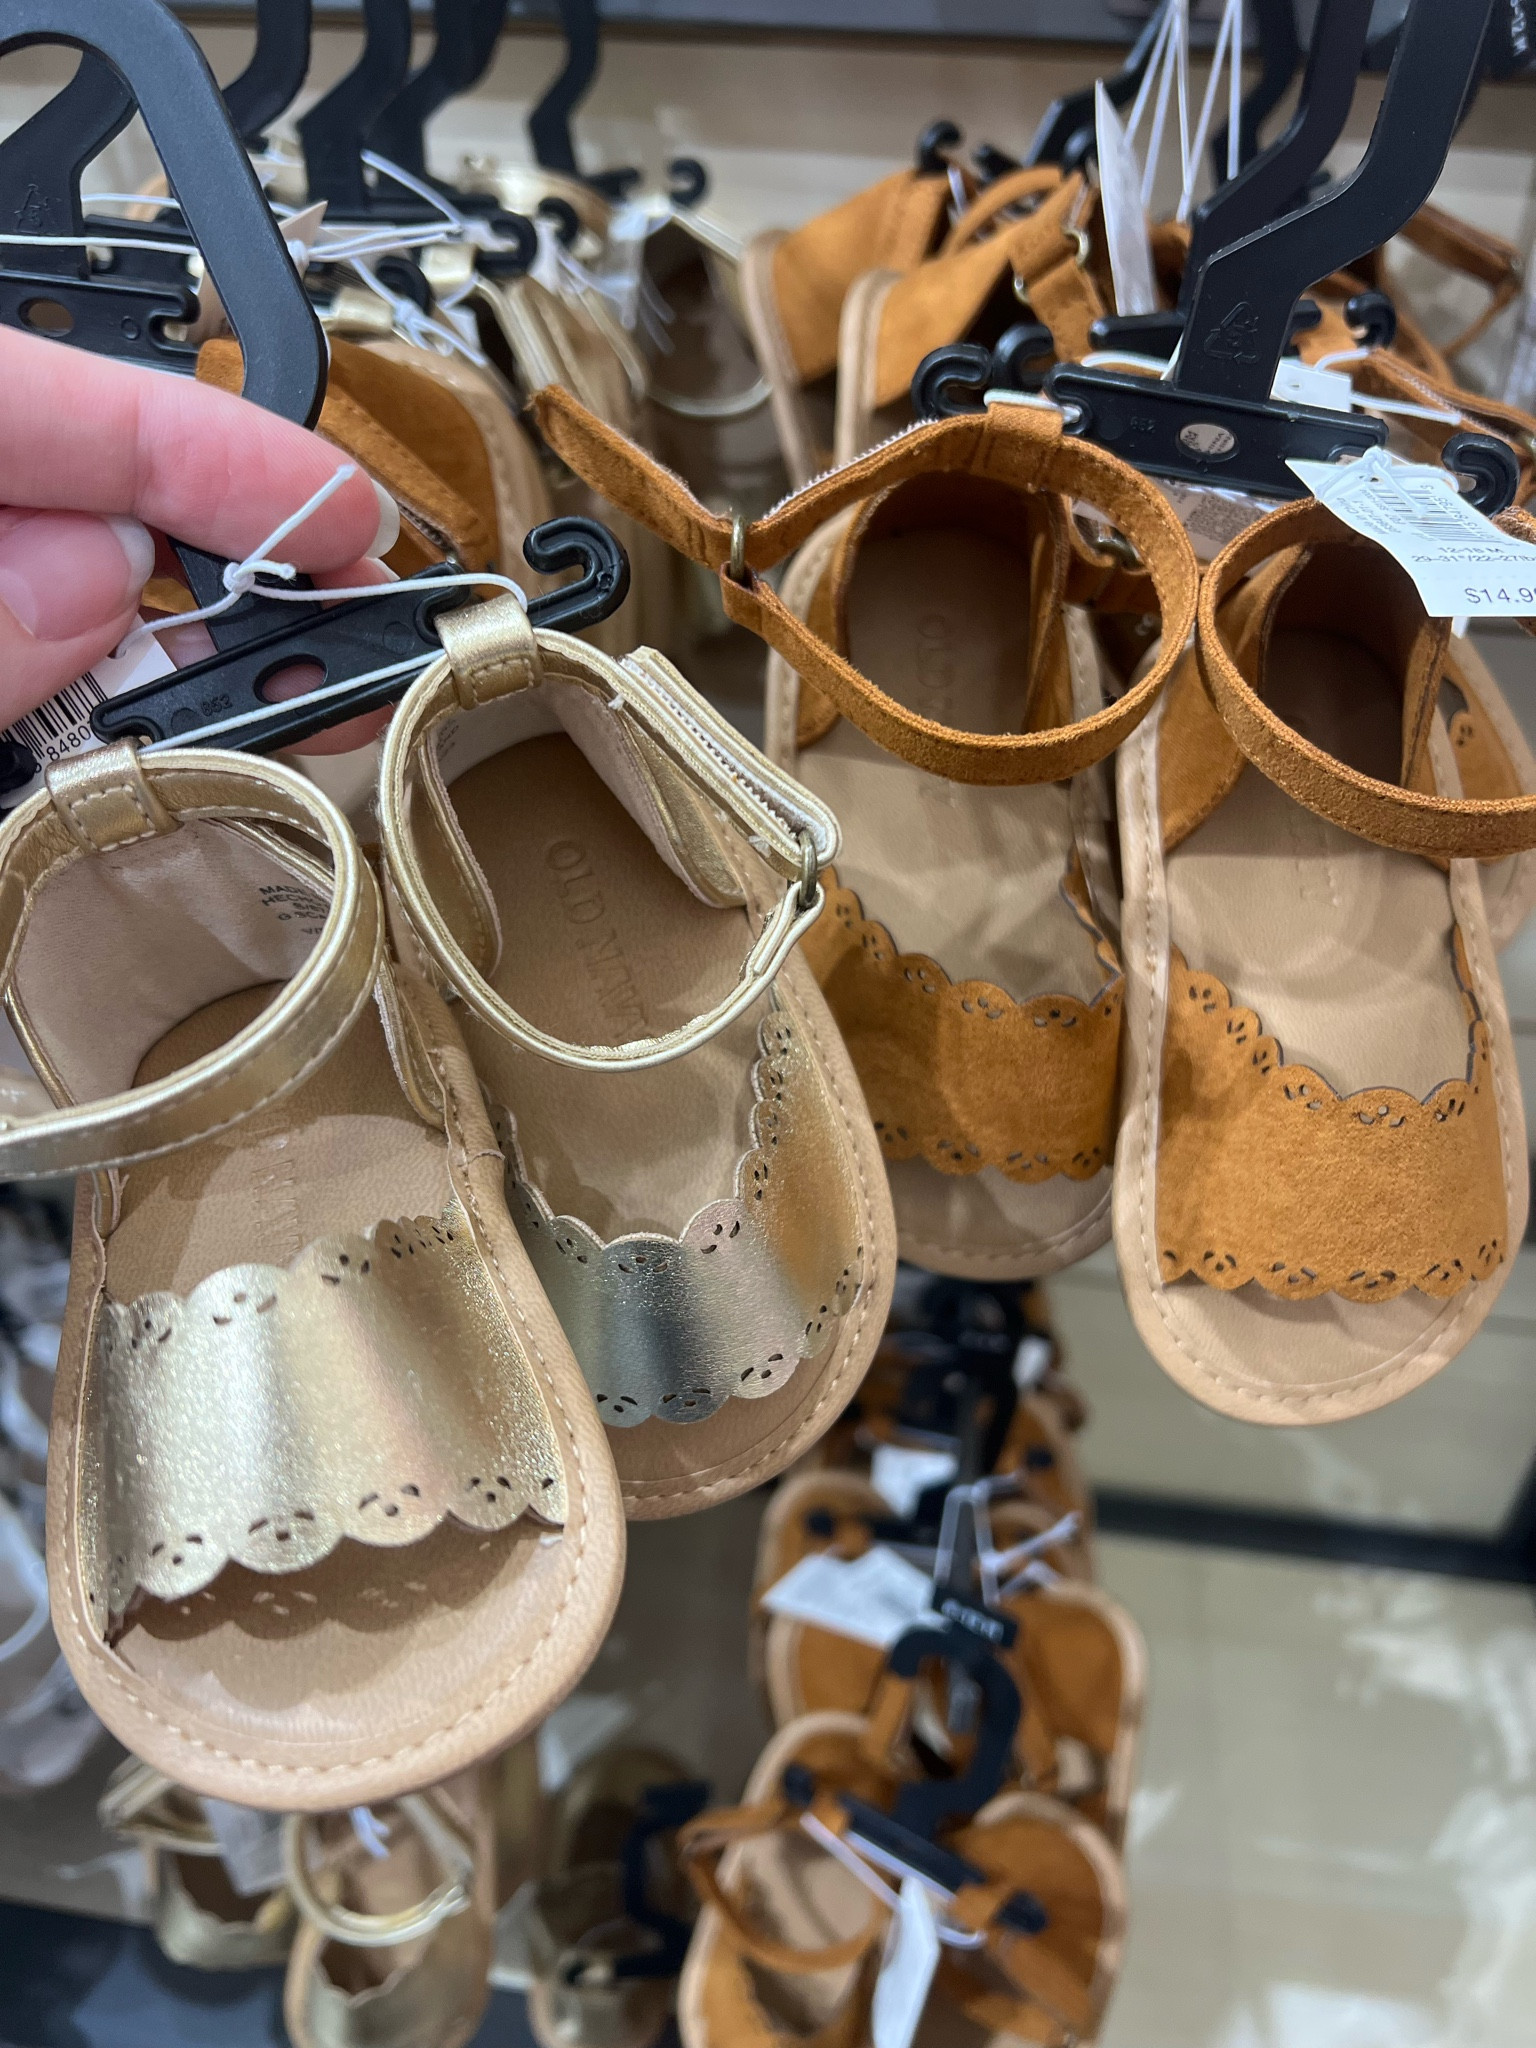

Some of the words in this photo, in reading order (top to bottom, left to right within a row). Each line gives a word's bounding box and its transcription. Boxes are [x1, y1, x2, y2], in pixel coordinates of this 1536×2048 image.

[1464, 587, 1536, 604] $14.9
[46, 722, 93, 761] 8480
[546, 840, 605, 925] OLD
